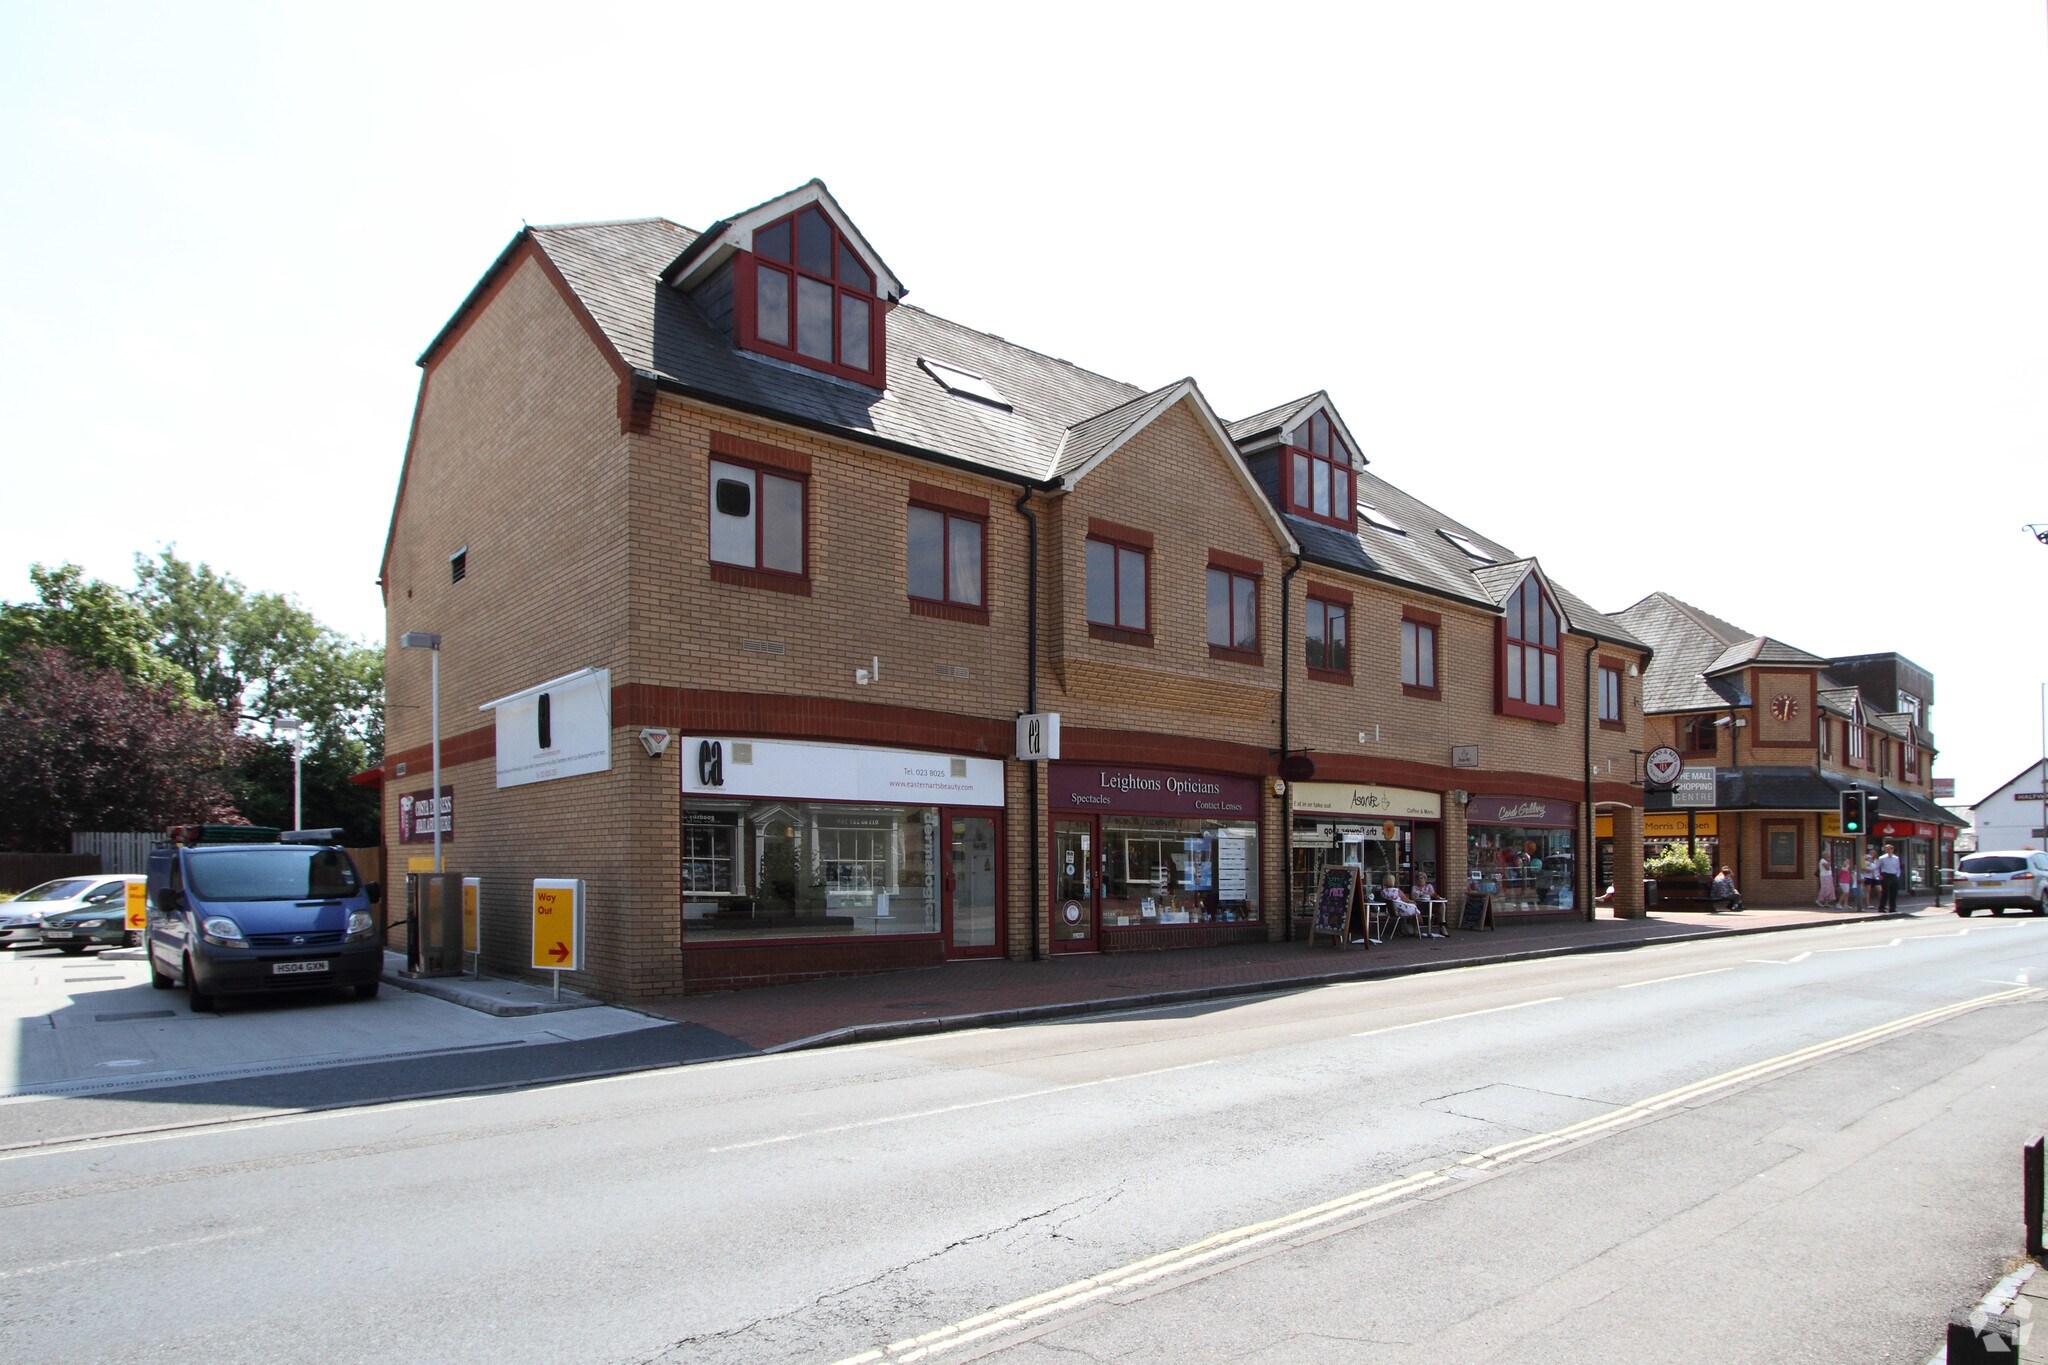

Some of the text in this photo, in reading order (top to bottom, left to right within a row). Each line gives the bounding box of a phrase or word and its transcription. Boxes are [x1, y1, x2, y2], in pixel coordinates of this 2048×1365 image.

[1029, 719, 1040, 754] ea
[699, 740, 724, 786] ea
[904, 767, 945, 778] Tel. 023 8025
[1692, 772, 1713, 780] MALL
[889, 780, 974, 791] www.easternartsbeauty.com
[1101, 772, 1220, 796] Leightons Opticians
[1071, 792, 1110, 805] Spectacles
[1350, 789, 1380, 809] Asante
[1675, 792, 1713, 802] CENTRE
[1195, 800, 1242, 811] Contact Lenses
[1499, 805, 1518, 819] Card
[1518, 802, 1546, 819] Gallery
[1645, 822, 1674, 830] Morris
[923, 813, 936, 927] dermalogica
[537, 892, 556, 903] Way
[537, 905, 553, 915] Out
[277, 962, 326, 972] HS04 GXN
